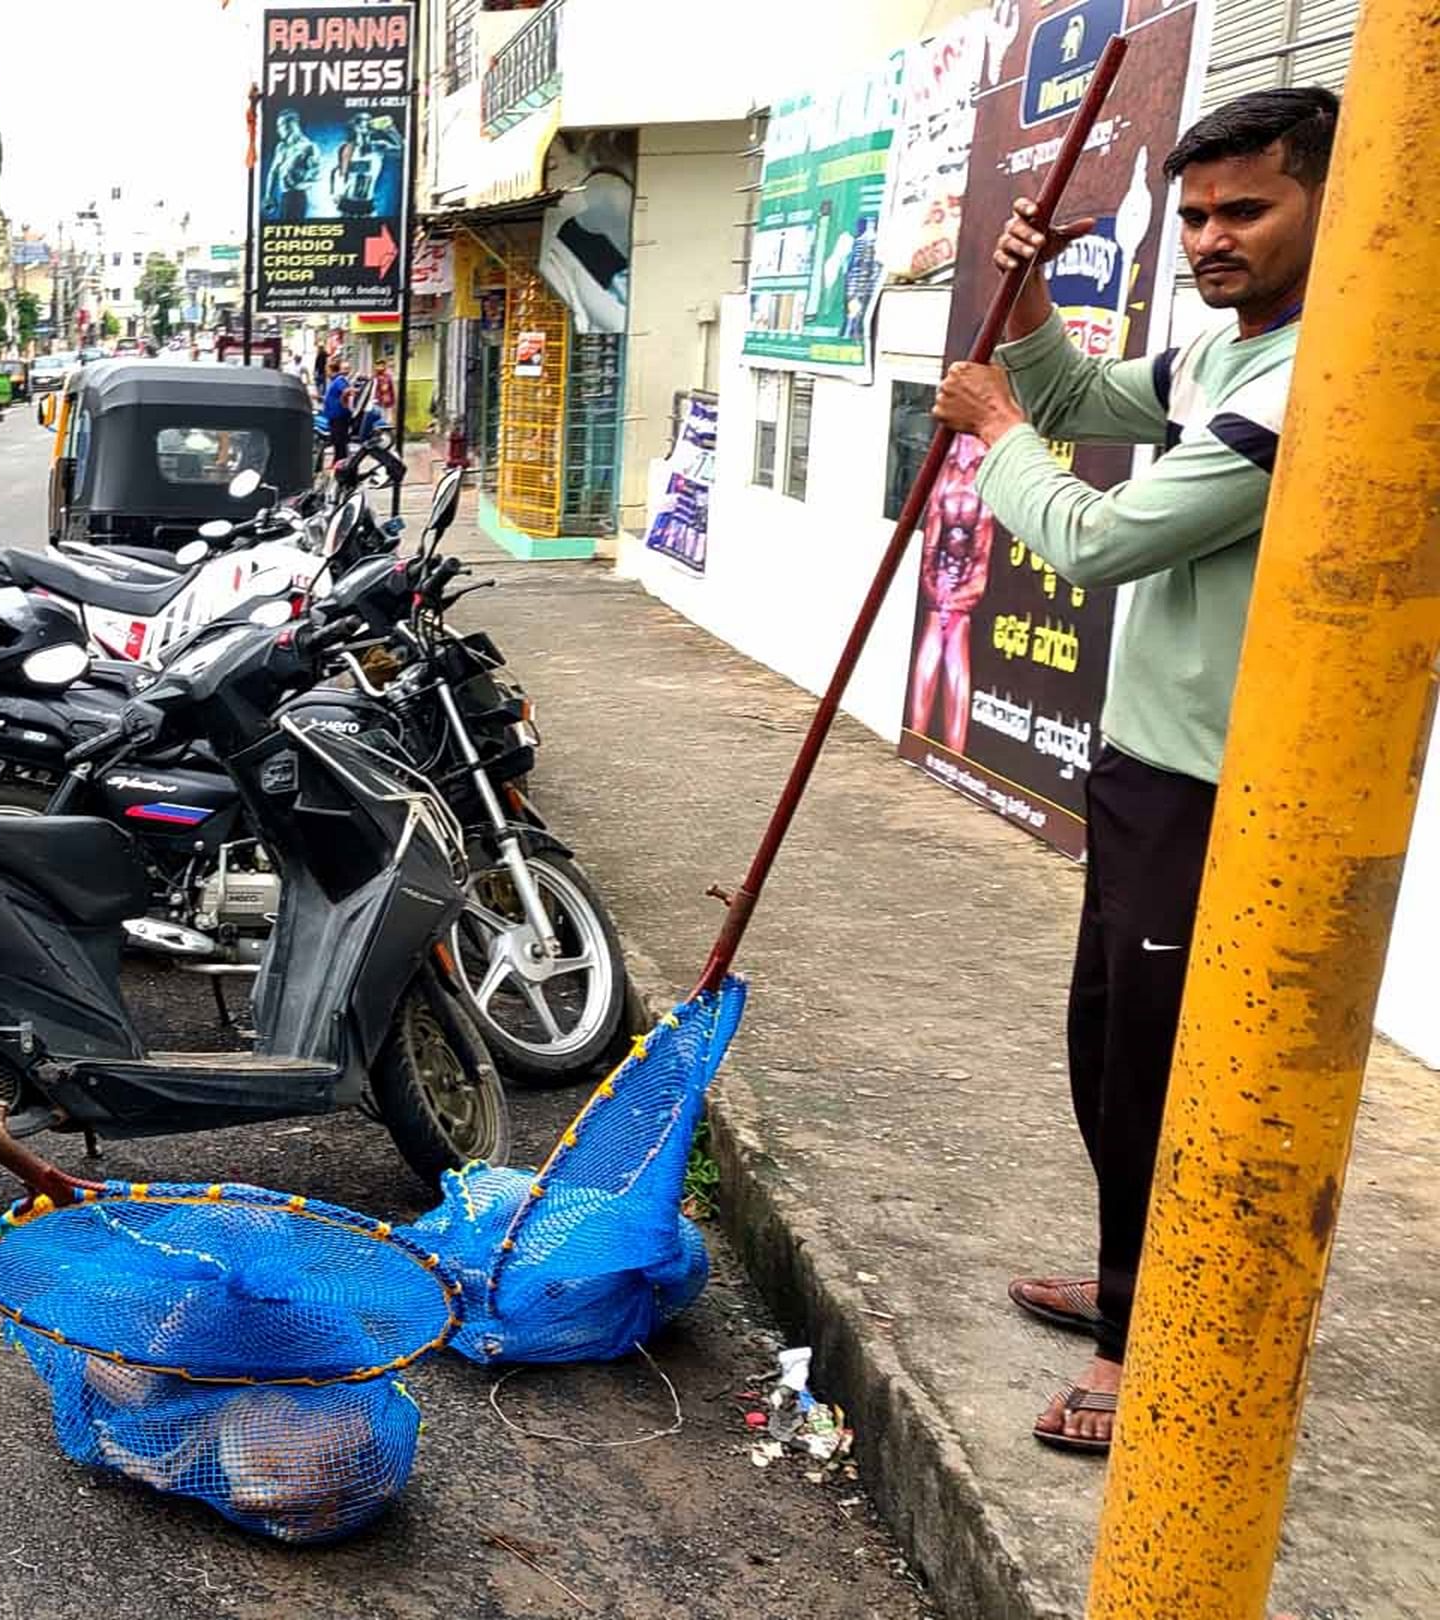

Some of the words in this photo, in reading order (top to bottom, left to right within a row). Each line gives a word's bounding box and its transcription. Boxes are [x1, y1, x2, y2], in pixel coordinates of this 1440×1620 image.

[268, 15, 407, 54] RAJANNA
[268, 60, 405, 97] FITNESS
[263, 224, 345, 239] FITNESS
[263, 239, 335, 253] CARDIO
[263, 253, 359, 268] CROSSFIT
[264, 269, 315, 283] YOGA
